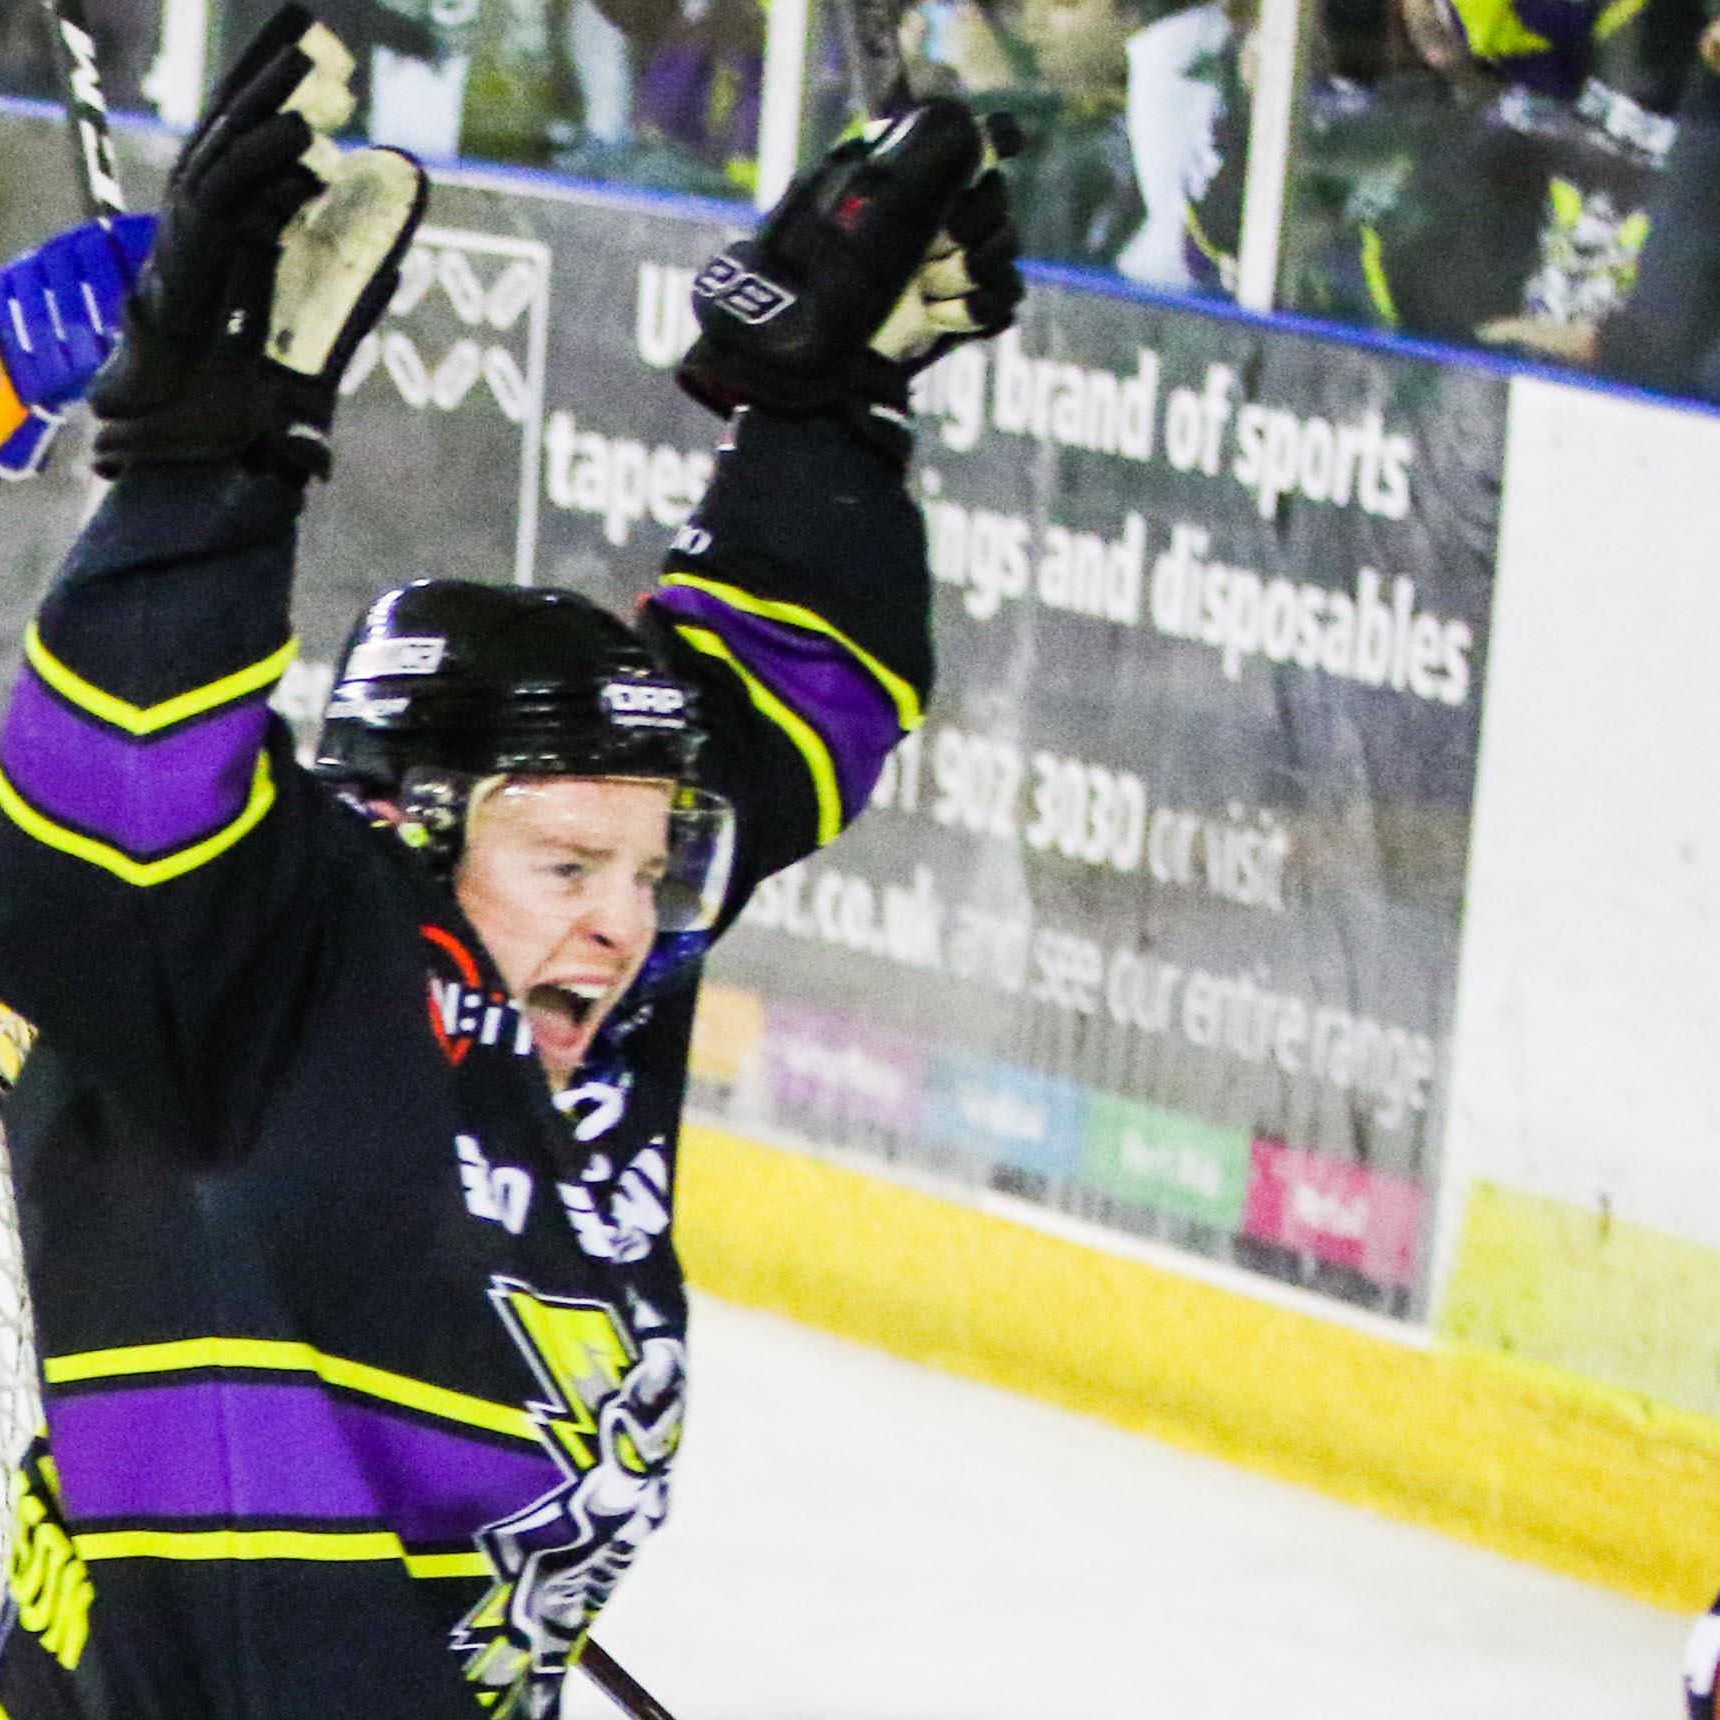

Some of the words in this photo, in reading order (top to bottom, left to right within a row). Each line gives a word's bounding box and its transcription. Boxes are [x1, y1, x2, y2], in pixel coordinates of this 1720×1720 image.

[995, 326, 1158, 465] brand
[1168, 362, 1232, 478] of
[1233, 404, 1414, 521] sports
[1039, 513, 1139, 625] and
[1151, 525, 1472, 707] disposables
[934, 729, 1023, 836] 902
[1026, 756, 1147, 873] 3030
[1148, 808, 1193, 882] or
[1204, 800, 1292, 911] visit
[743, 862, 943, 970] st.co.uk
[1035, 934, 1104, 1016] see
[1107, 950, 1177, 1030] our
[1182, 962, 1303, 1073] entire
[1309, 1012, 1434, 1126] range
